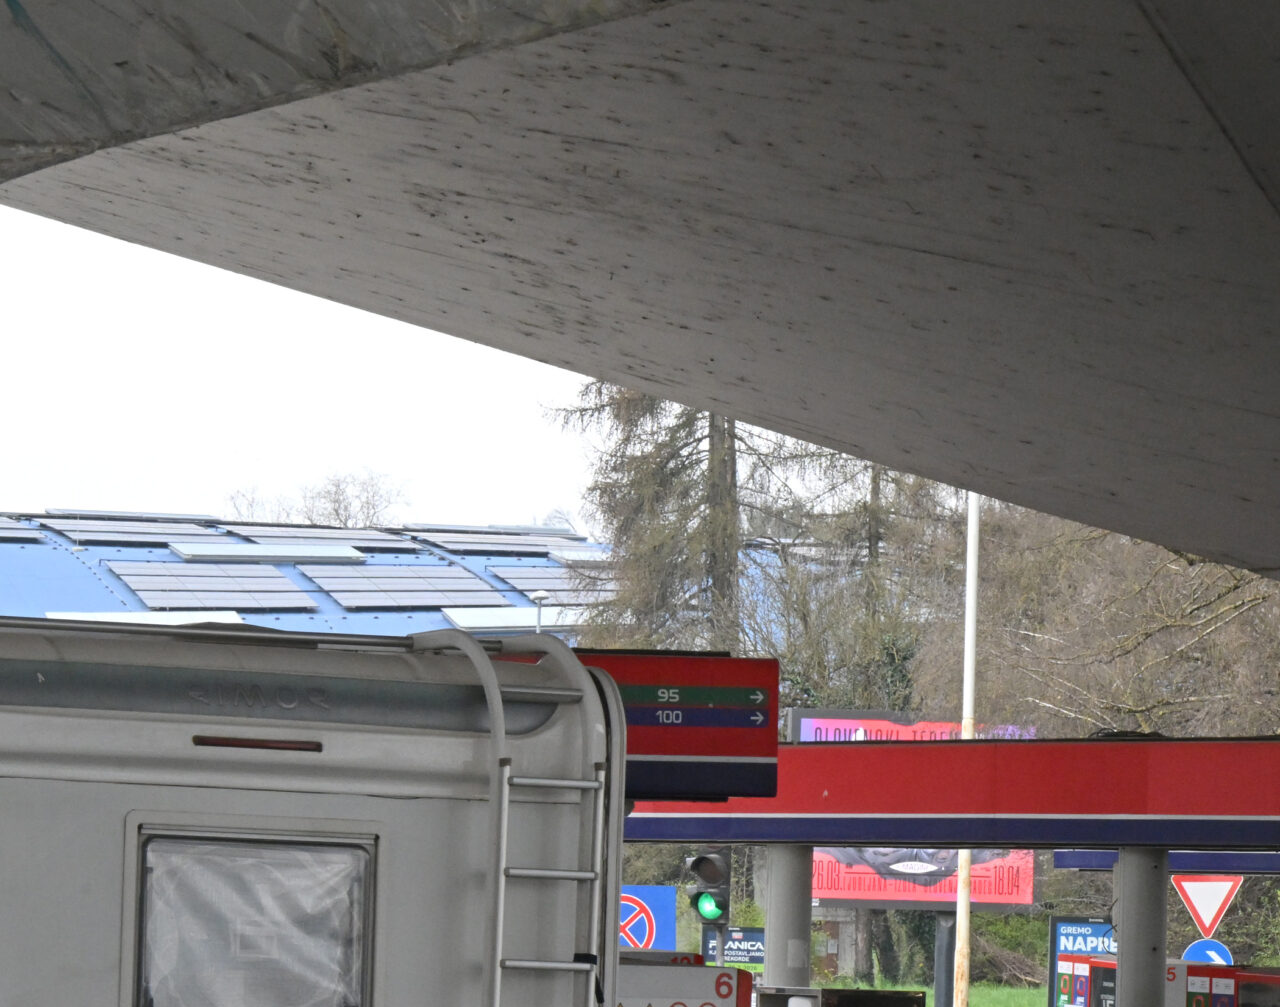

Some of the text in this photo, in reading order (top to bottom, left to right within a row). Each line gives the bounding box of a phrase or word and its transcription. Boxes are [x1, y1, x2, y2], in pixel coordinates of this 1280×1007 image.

[657, 688, 680, 702] 95
[655, 710, 683, 724] 100
[1060, 926, 1092, 935] GREMO
[708, 940, 765, 951] PANICA
[1166, 967, 1177, 982] 5
[715, 972, 733, 999] 6
